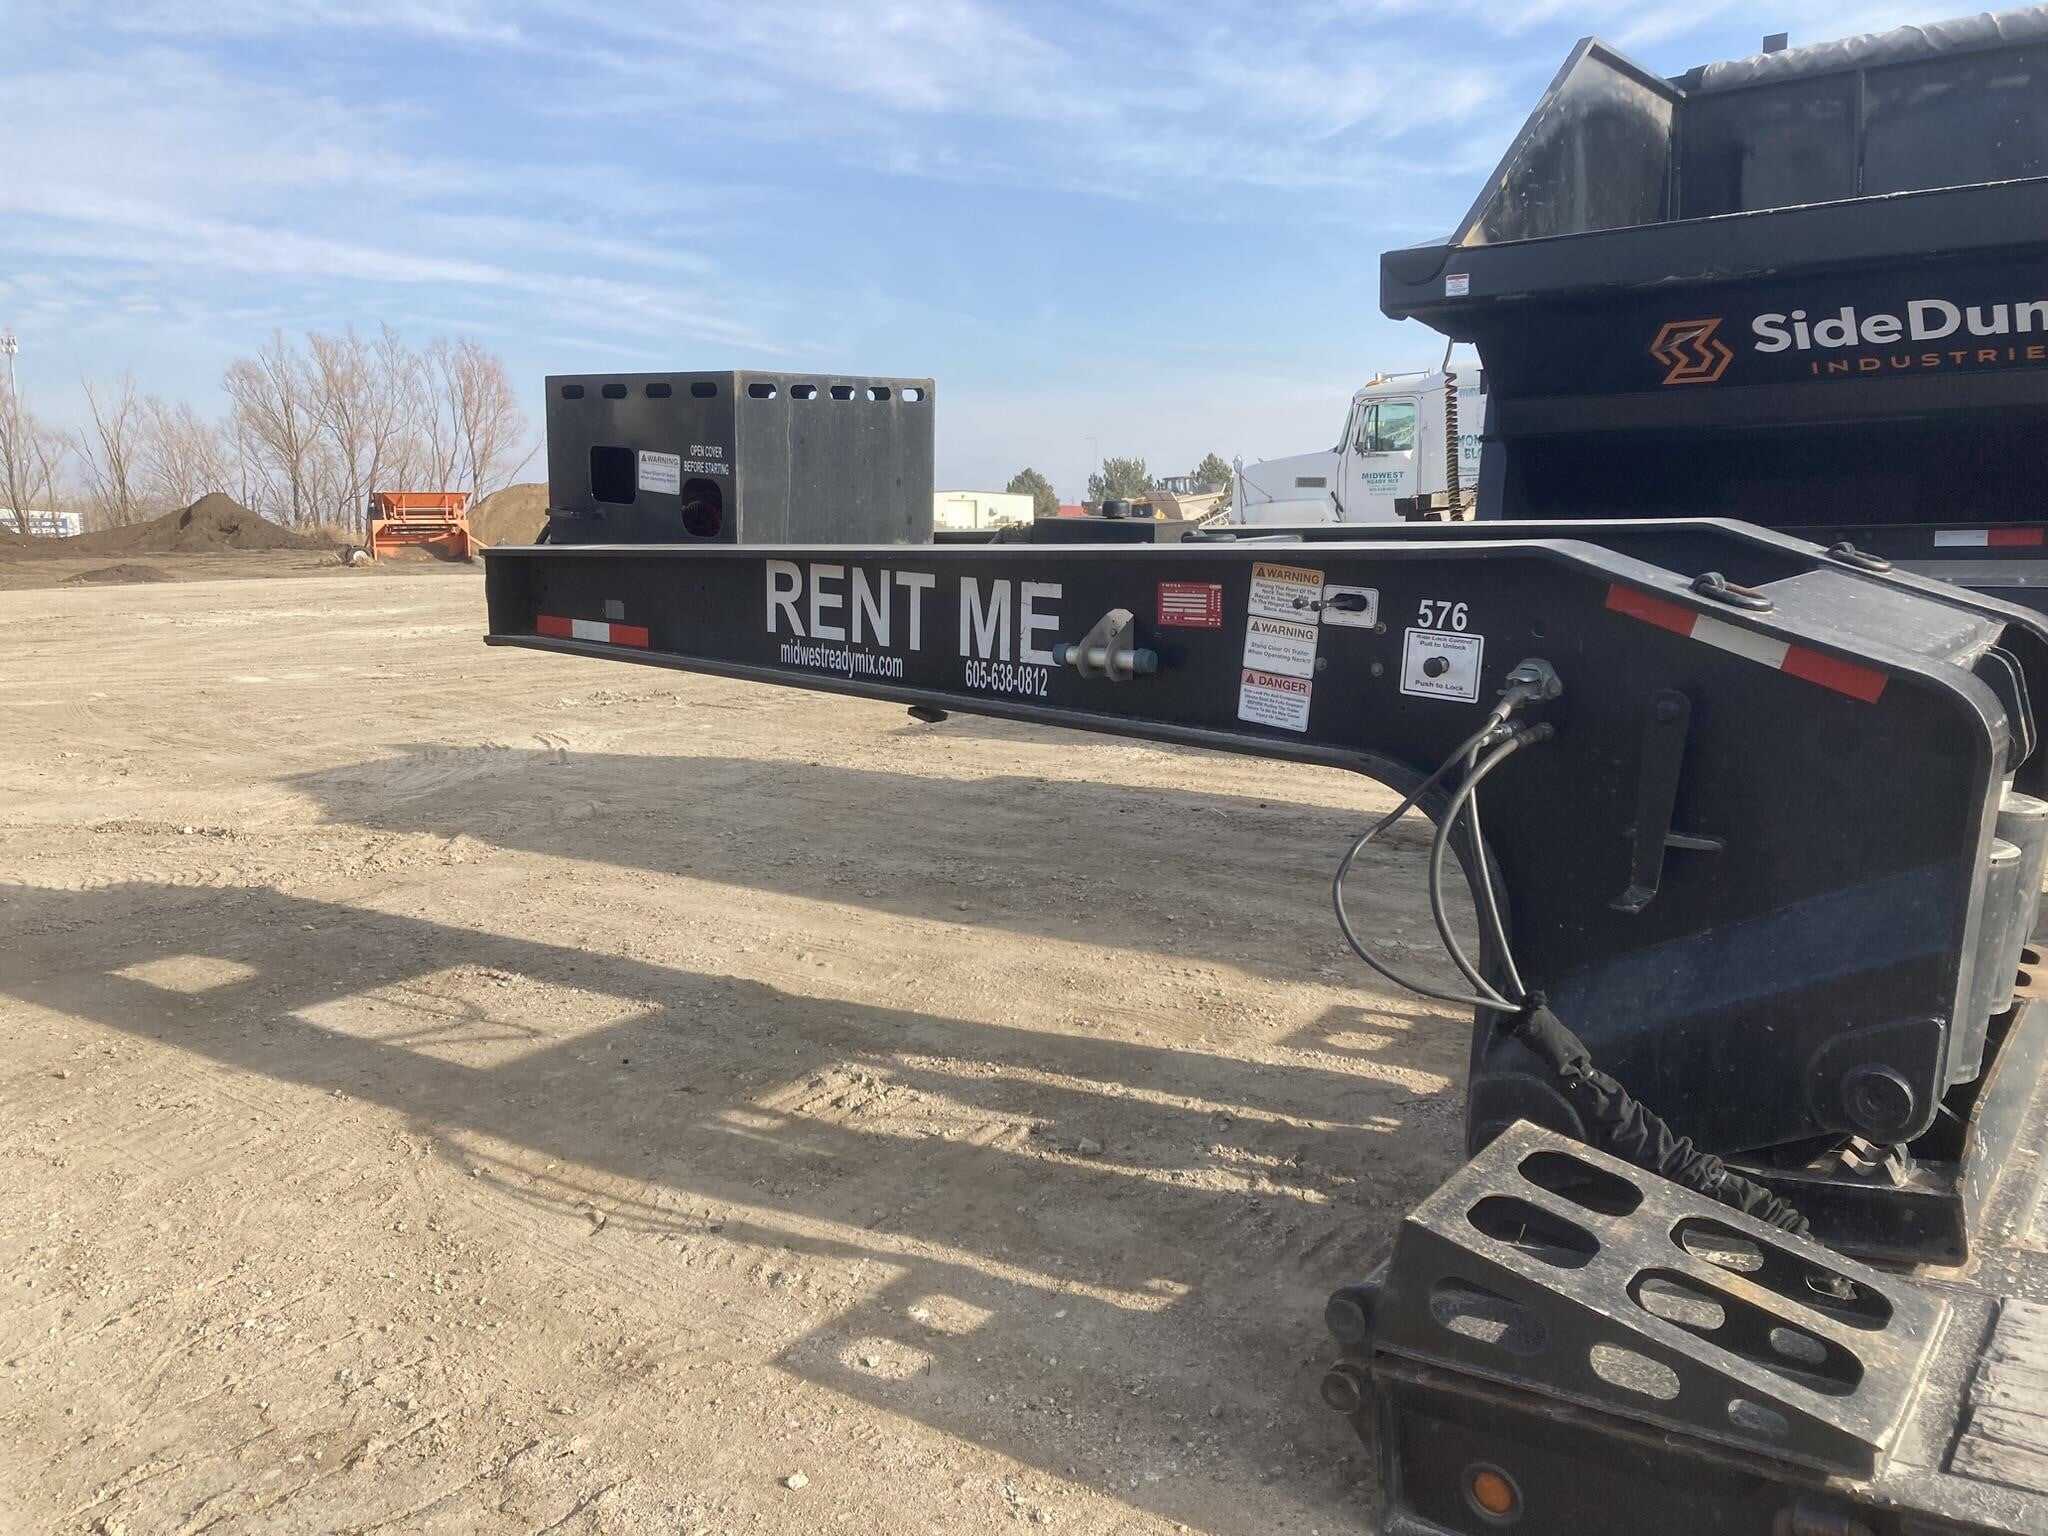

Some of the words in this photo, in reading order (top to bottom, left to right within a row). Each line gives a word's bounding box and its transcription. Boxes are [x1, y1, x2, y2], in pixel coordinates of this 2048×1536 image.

[690, 445, 704, 456] OPEN
[705, 446, 722, 458] COVER
[648, 455, 679, 466] WARNING
[684, 460, 704, 473] BEFORE
[705, 462, 729, 475] STARTING
[1361, 471, 1404, 479] MIDWEST
[1266, 570, 1320, 585] WARNING
[766, 559, 936, 651] RENT
[959, 576, 1063, 667] ME
[1417, 599, 1469, 632] 576
[1261, 623, 1313, 640] WARNING
[1443, 643, 1466, 651] Unlock
[780, 640, 903, 678] midwestreadymix.com
[965, 659, 1048, 696] 605-638-0812
[1258, 676, 1307, 693] DANGER
[1415, 680, 1434, 688] Push
[1445, 683, 1463, 691] Lock
